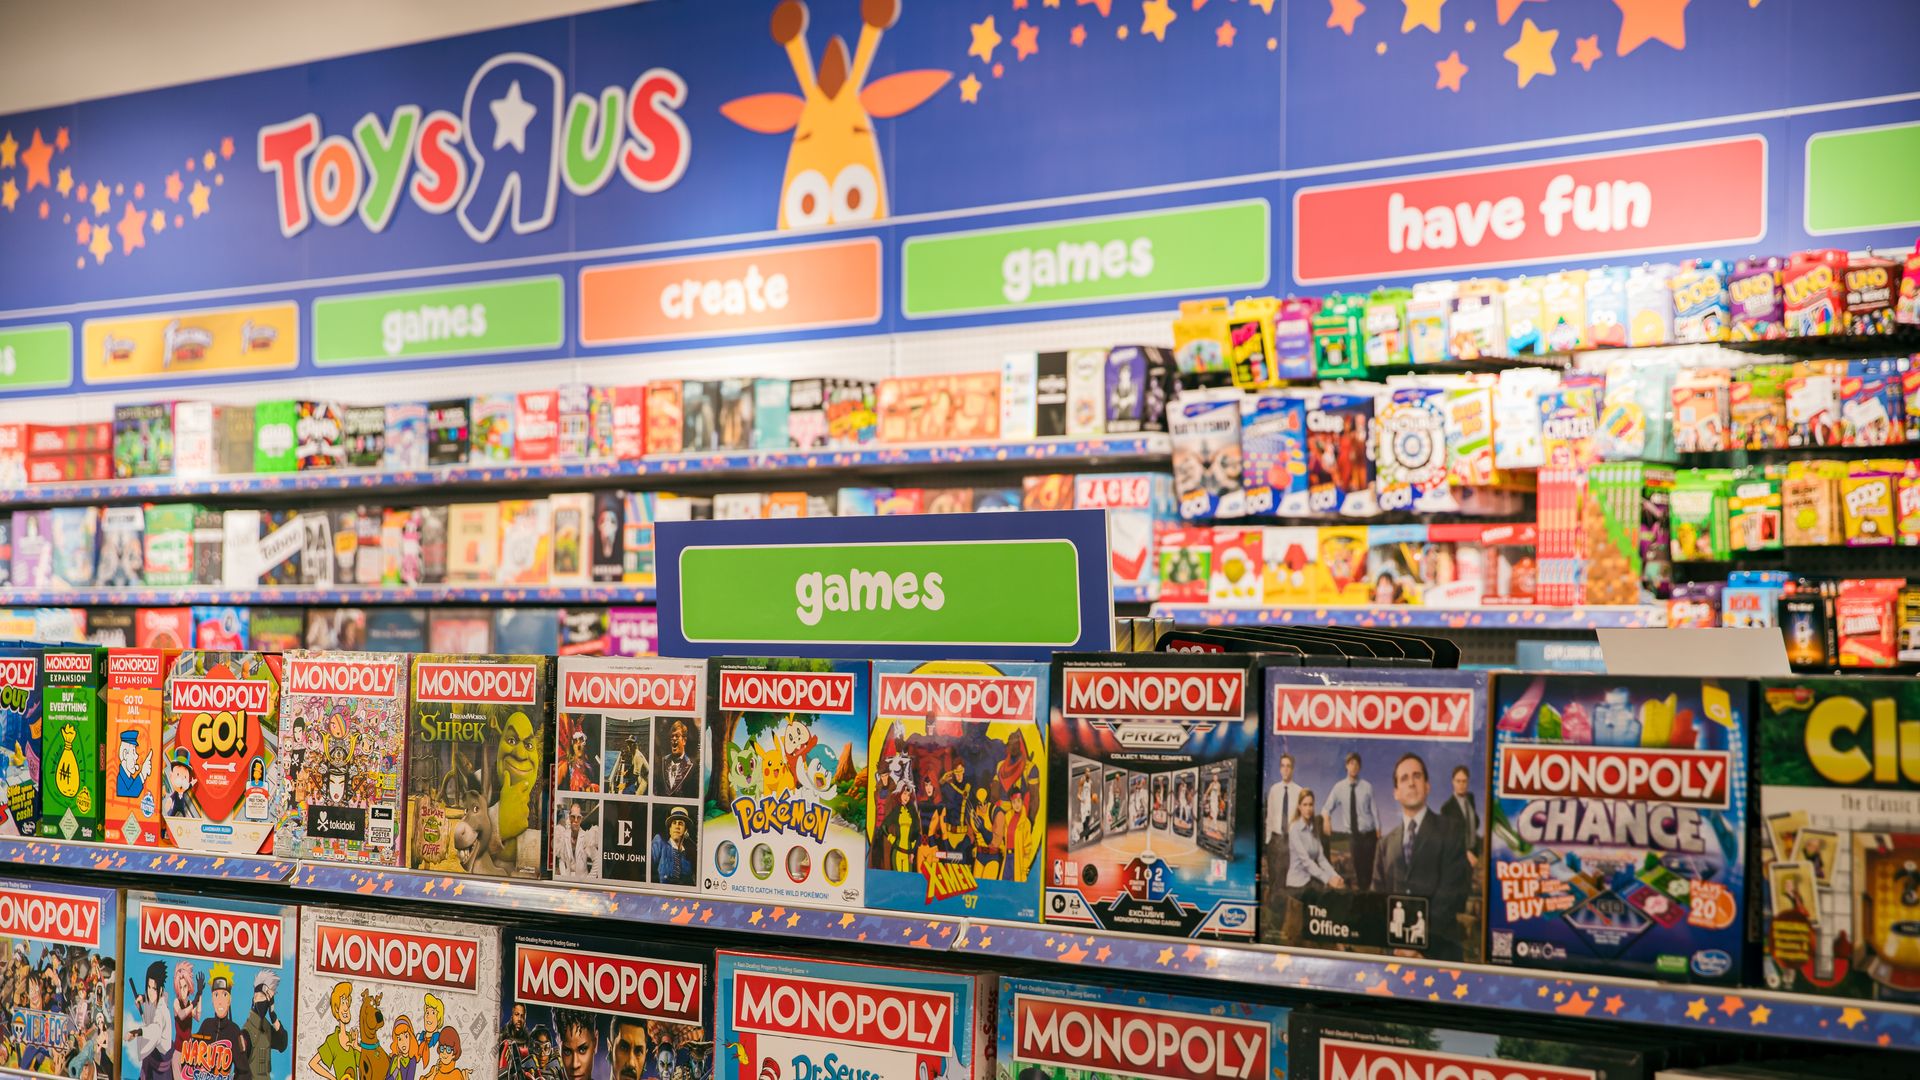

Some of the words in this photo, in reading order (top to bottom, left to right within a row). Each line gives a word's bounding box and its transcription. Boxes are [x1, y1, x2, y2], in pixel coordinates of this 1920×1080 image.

[1388, 192, 1525, 254] have
[1539, 173, 1652, 237] fun
[1002, 236, 1154, 302] games
[1847, 267, 1889, 290] UNO
[660, 264, 789, 320] create
[1729, 272, 1774, 302] UNO
[1784, 265, 1833, 304] UNO
[382, 302, 487, 355] games
[795, 568, 946, 627] games
[46, 656, 91, 670] MONOPOLY
[111, 658, 158, 674] MONOPOLY
[50, 673, 86, 683] EXPANSION
[115, 675, 153, 685] EXPANSION
[292, 665, 395, 693] MONOPOLY
[421, 669, 533, 698] MONOPOLY
[568, 675, 694, 707] MONOPOLY
[725, 676, 850, 707] MONOPOLY
[1, 685, 29, 713] OUT
[49, 702, 87, 713] EVERYTHING
[61, 692, 75, 702] BUY
[123, 695, 134, 705] GO
[135, 696, 144, 705] TO
[174, 684, 267, 709] MONOPOLY
[884, 680, 1032, 716] MONOPOLY
[1070, 676, 1239, 712] MONOPOLY
[127, 705, 140, 715] JAIL
[1281, 693, 1468, 733] MONOPOLY
[191, 710, 248, 759] GO!
[419, 710, 487, 744] SHREK
[1121, 731, 1181, 743] PRIZM
[1507, 753, 1725, 800] MONOPOLY
[421, 805, 445, 819] BEWARE
[1842, 793, 1861, 811] The
[329, 820, 356, 831] tokidoki
[617, 819, 633, 847] E
[1518, 796, 1706, 855] CHANCE
[422, 843, 441, 856] OGRE
[603, 851, 625, 861] ELTON
[626, 853, 646, 863] JOHN
[921, 860, 978, 906] X-MEN
[1134, 866, 1141, 880] 1
[1155, 867, 1164, 881] 2
[1496, 860, 1539, 879] ROLL
[731, 884, 746, 894] RACE
[746, 886, 754, 894] TO
[754, 887, 774, 896] CATCH
[774, 888, 785, 897] THE
[785, 890, 799, 898] WILD
[1502, 879, 1540, 901] FLIP
[1128, 909, 1165, 918] EXCLUSIVE
[1308, 904, 1327, 918] The
[1505, 896, 1544, 923] BUY
[1691, 897, 1717, 920] 20
[144, 911, 279, 959] MONOPOLY
[1309, 919, 1349, 937] Office
[320, 931, 475, 983] MONOPOLY
[522, 953, 697, 1014] MONOPOLY
[741, 980, 948, 1045] MONOPOLY
[181, 1039, 233, 1071] NARUTO
[1023, 1005, 1263, 1080] MONOPOLY
